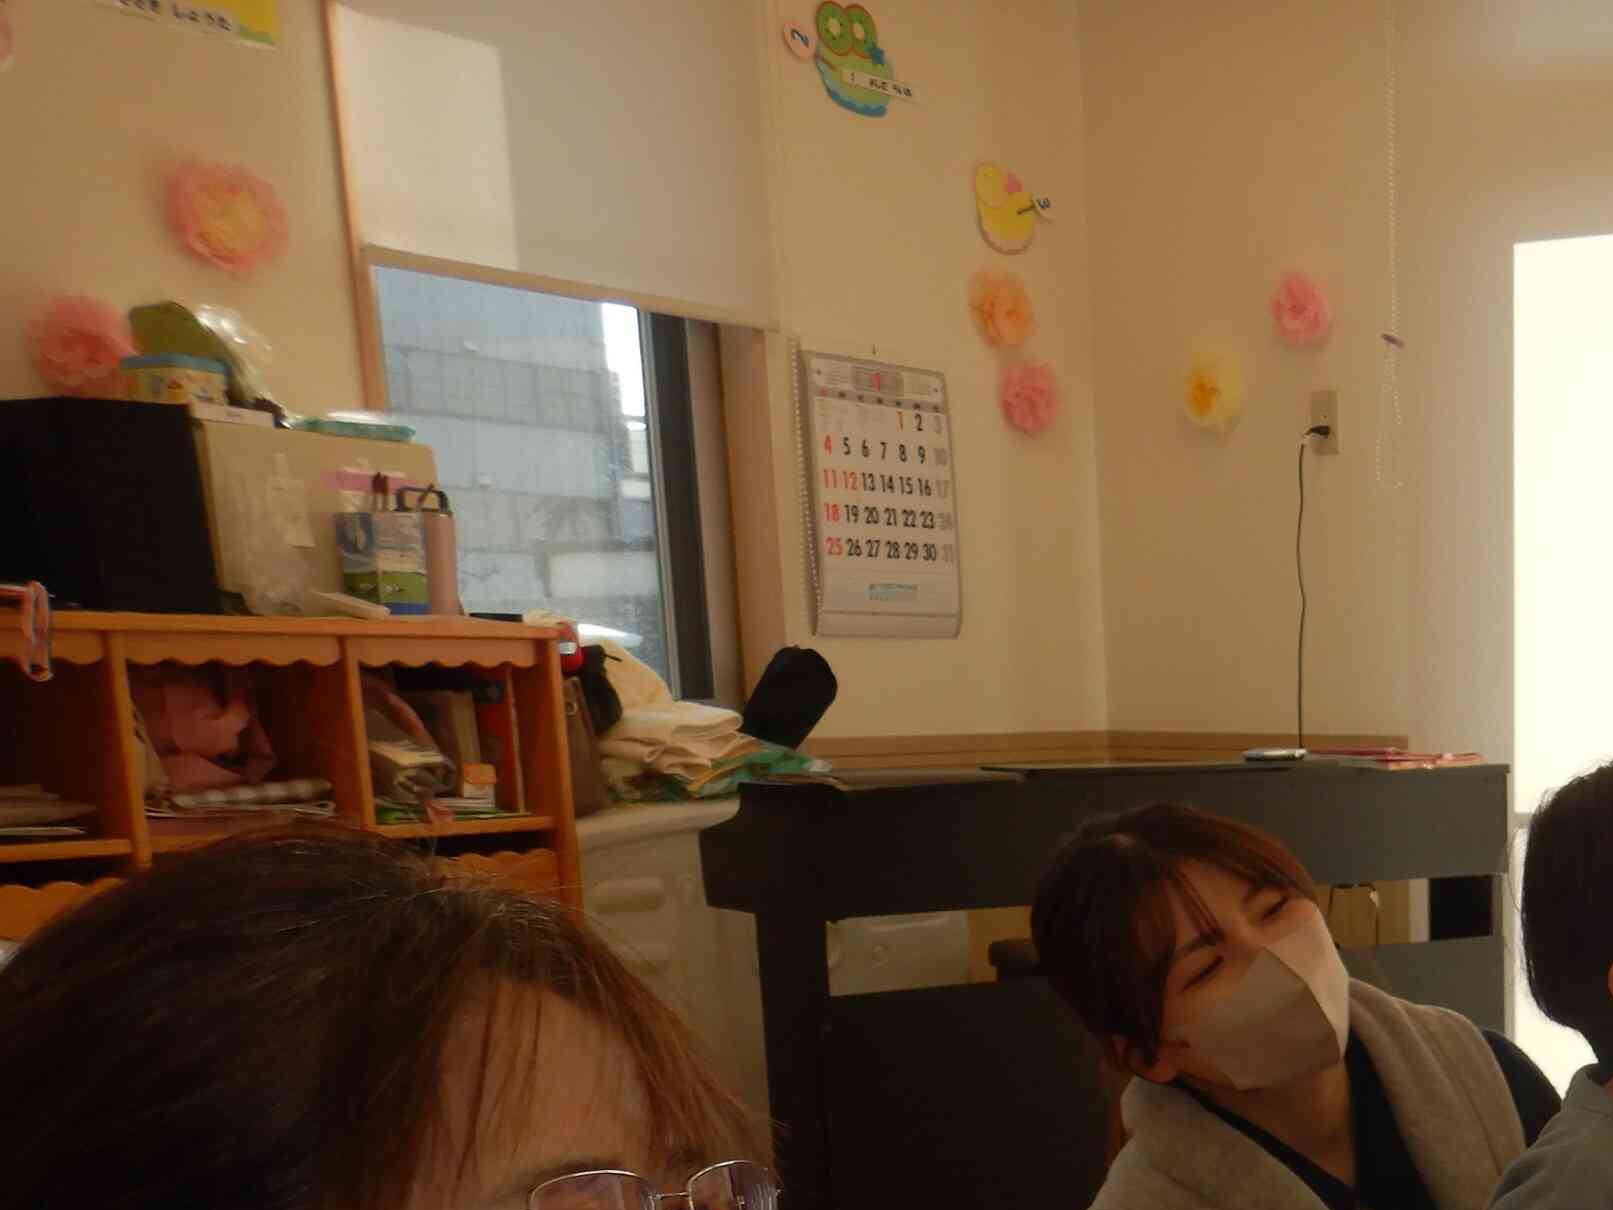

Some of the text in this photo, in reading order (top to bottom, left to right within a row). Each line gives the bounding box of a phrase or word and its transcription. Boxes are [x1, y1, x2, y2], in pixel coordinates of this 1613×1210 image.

[897, 411, 942, 434] 1 2 3
[824, 435, 947, 466] 4 5 6 7 8 9 10
[823, 469, 949, 498] 11 12 13 14 15 16 17
[824, 502, 839, 522] 18
[844, 504, 859, 524] 19
[864, 506, 879, 525] 20
[884, 508, 898, 526] 21
[902, 509, 916, 528] 22
[921, 511, 934, 529] 23
[826, 537, 842, 556] 25
[846, 538, 862, 557] 26
[866, 539, 880, 558] 27
[886, 541, 900, 559] 28
[904, 542, 919, 560] 29
[922, 543, 936, 561] 30
